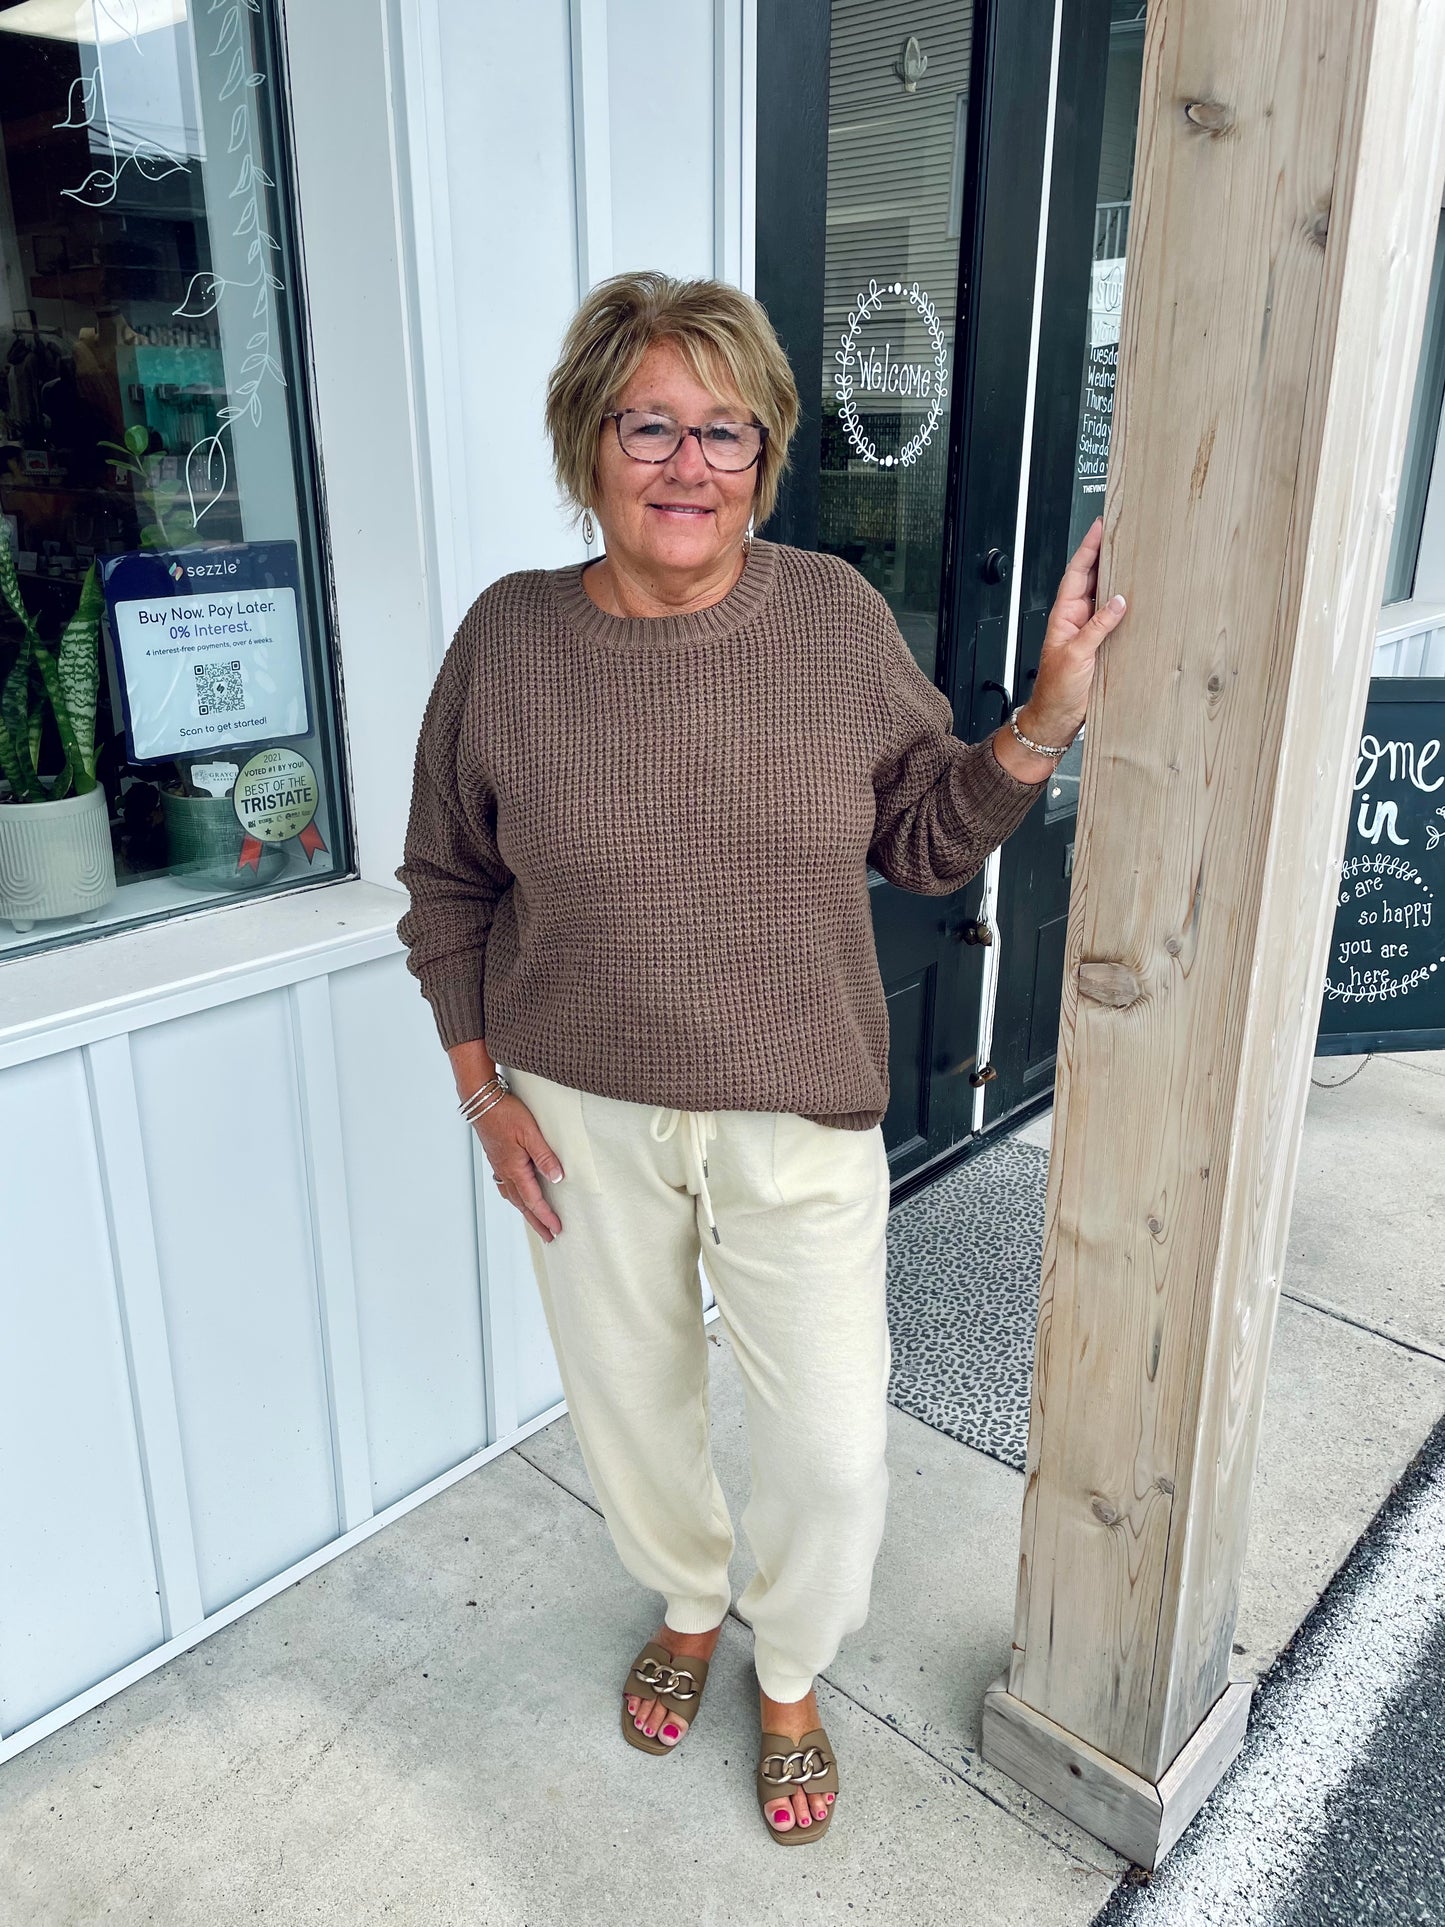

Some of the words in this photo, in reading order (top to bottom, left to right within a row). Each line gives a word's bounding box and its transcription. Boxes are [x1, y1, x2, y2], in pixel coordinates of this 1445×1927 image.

[186, 559, 237, 577] sezzle
[138, 610, 167, 626] Buy
[171, 606, 205, 621] Now.
[208, 603, 234, 619] Pay
[237, 600, 276, 615] Later.
[169, 624, 191, 640] 0%
[194, 620, 253, 637] Interest.
[152, 645, 196, 656] interest-free
[197, 640, 232, 652] payments,
[232, 639, 247, 647] over
[179, 726, 204, 737] Scan
[205, 724, 215, 733] to
[216, 721, 232, 733] get
[233, 716, 268, 729] started!
[263, 753, 282, 764] 2021
[244, 767, 267, 778] VOTED
[268, 764, 276, 773] #1
[278, 763, 287, 772] BY
[244, 782, 270, 797] BEST
[273, 779, 286, 793] OF
[289, 775, 307, 789] THE
[241, 788, 312, 814] TRISTATE
[1357, 793, 1410, 845] in
[1354, 876, 1384, 898] are
[1358, 910, 1378, 925] so
[1382, 900, 1432, 928] happy
[1338, 939, 1372, 963] you
[1380, 943, 1409, 958] are
[1349, 965, 1391, 987] here
